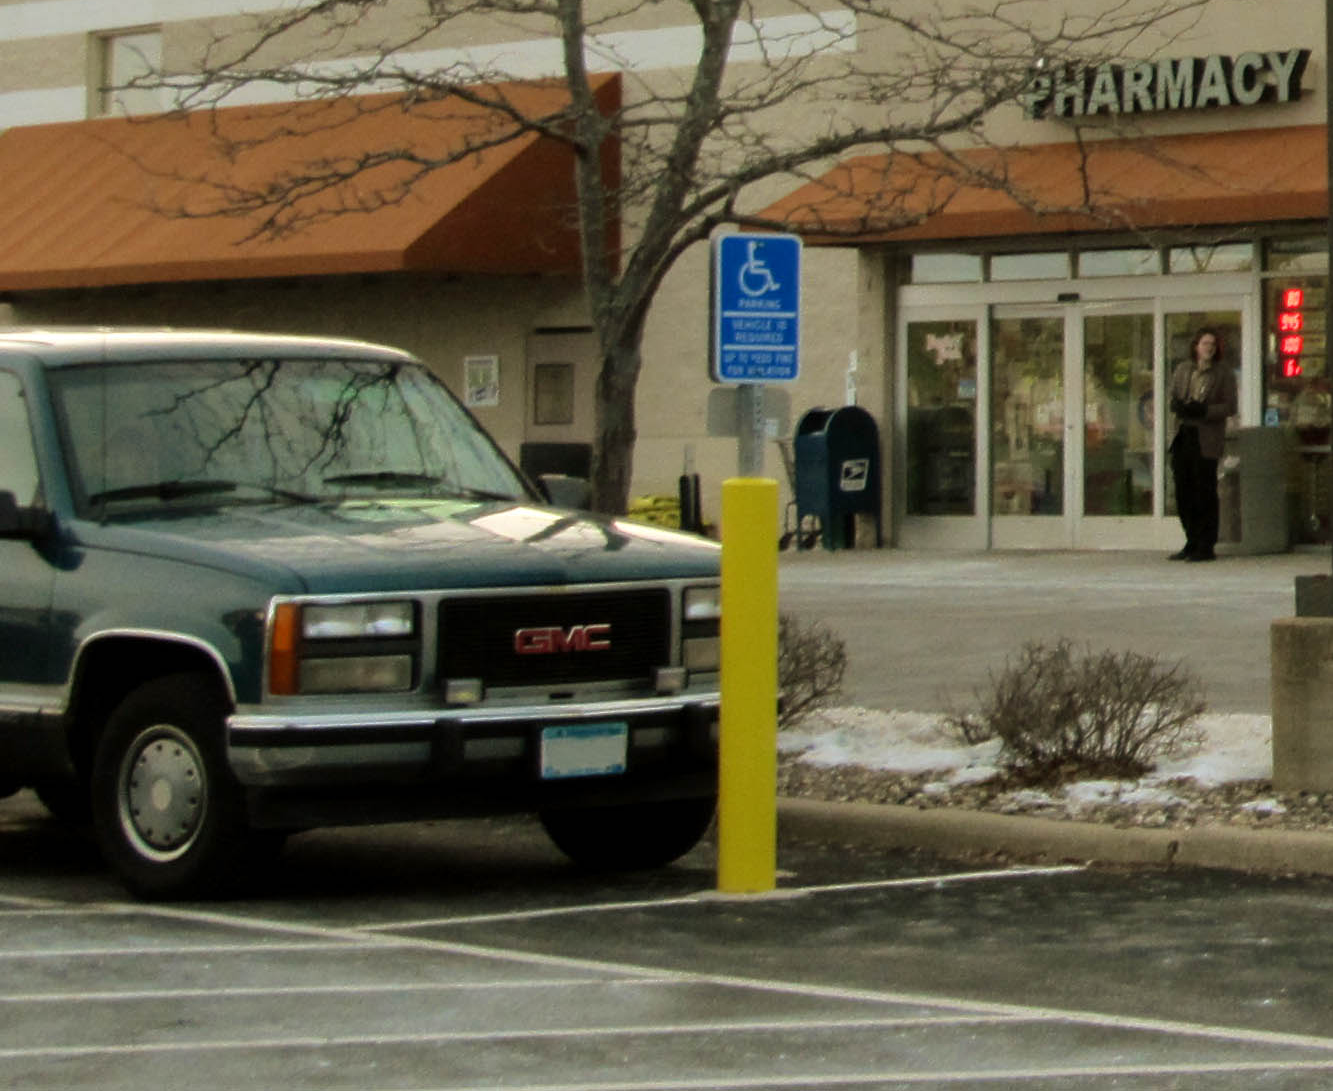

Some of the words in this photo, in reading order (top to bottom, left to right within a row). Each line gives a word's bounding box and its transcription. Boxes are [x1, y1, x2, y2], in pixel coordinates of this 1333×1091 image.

[1023, 49, 1311, 120] PHARMACY
[738, 299, 782, 308] PARKING
[515, 624, 611, 653] GMC
